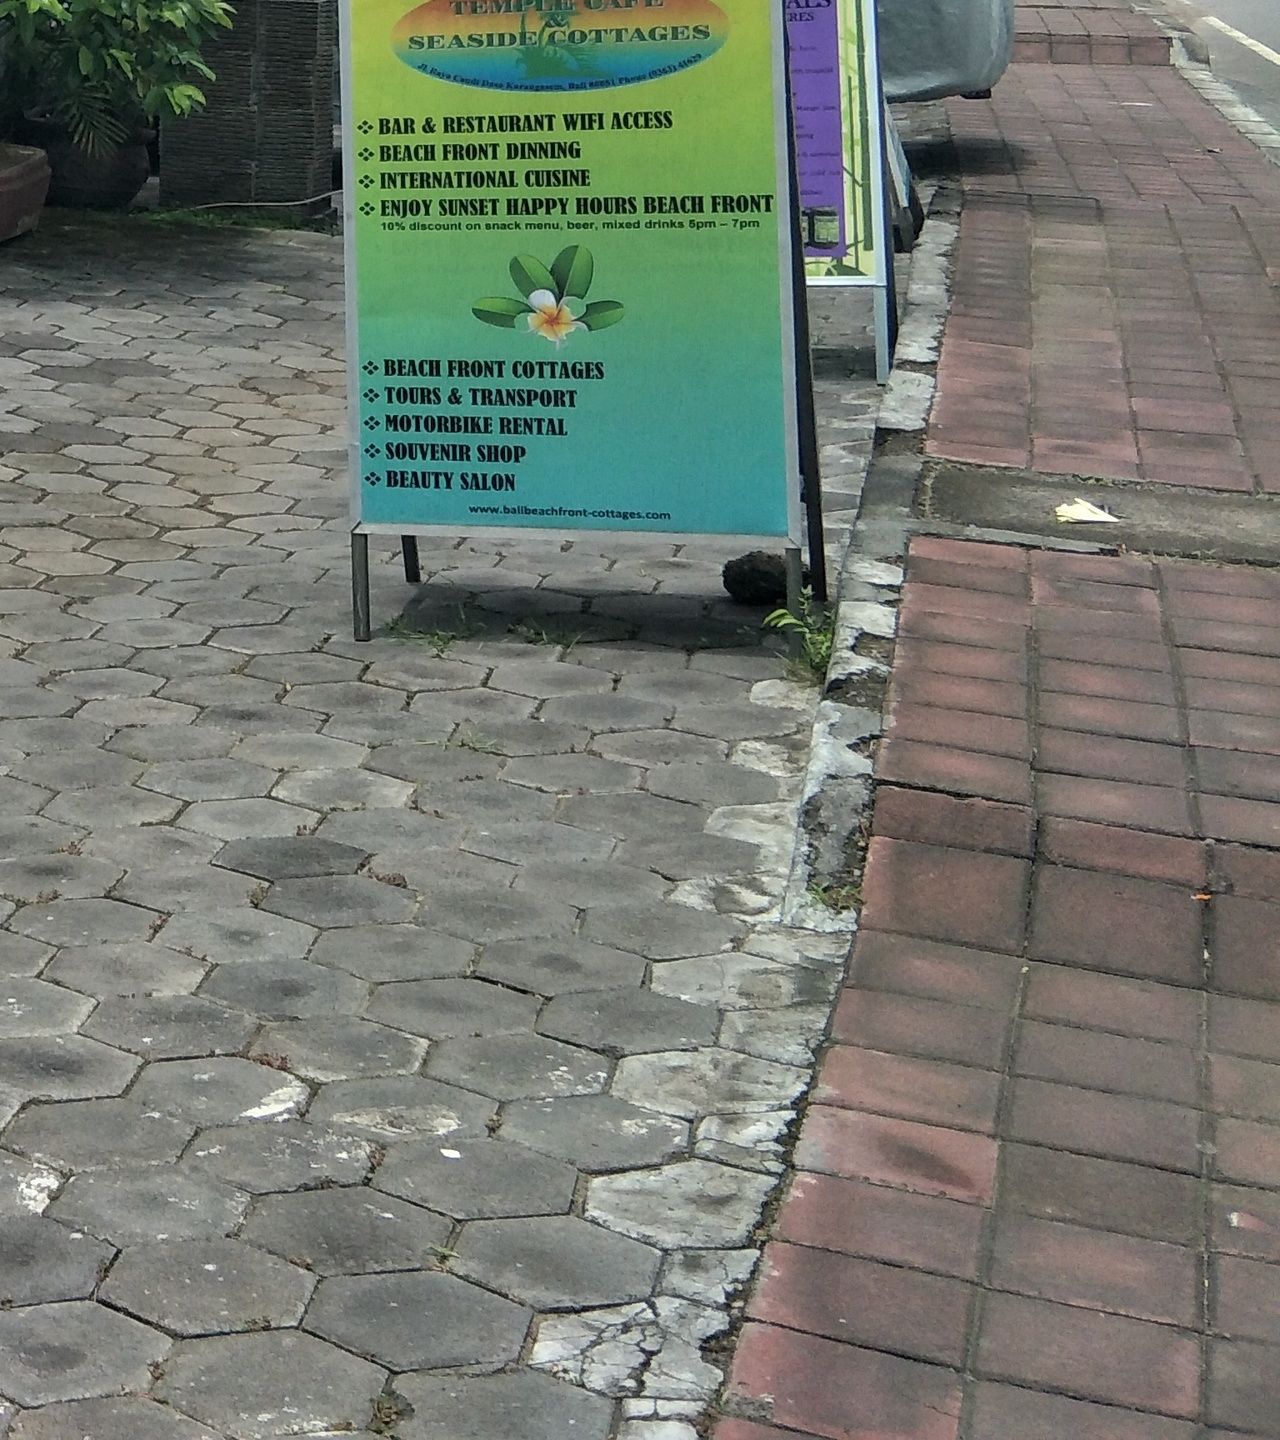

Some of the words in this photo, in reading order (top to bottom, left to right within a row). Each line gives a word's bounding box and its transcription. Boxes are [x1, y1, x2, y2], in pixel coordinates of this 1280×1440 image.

[545, 13, 569, 29] &
[408, 30, 541, 51] SEASIDE
[547, 24, 711, 45] COTTAGES
[453, 74, 480, 86] Candi
[378, 116, 417, 135] BAR
[421, 116, 436, 135] &
[443, 114, 556, 134] RESTAURANT
[562, 112, 605, 131] WIFI
[611, 110, 673, 131] ACCESS
[378, 142, 437, 162] BEACH
[442, 141, 502, 161] FRONT
[505, 140, 581, 160] DINNING
[379, 169, 519, 190] INTERNATIONAL
[523, 168, 591, 188] CUISINE
[380, 198, 433, 219] ENJOY
[438, 197, 501, 217] SUNSET
[505, 196, 571, 216] HAPPY
[575, 196, 638, 216] HOURS
[643, 195, 706, 215] BEACH
[710, 193, 774, 214] FRONT
[381, 221, 407, 231] 10%
[409, 221, 461, 231] discount
[464, 223, 481, 231] on
[484, 220, 522, 230] snack
[524, 222, 564, 232] menu,
[566, 220, 598, 231] beer,
[601, 219, 640, 230] mixed
[644, 219, 685, 230] drinks
[688, 219, 717, 232] 5pm
[732, 219, 760, 232] 7pm
[383, 359, 441, 378] BEACH
[447, 360, 506, 378] FRONT
[512, 361, 605, 380] COTTAGES
[384, 386, 441, 405] TOURS
[447, 388, 462, 405] &
[468, 388, 578, 408] TRANSPORT
[384, 415, 493, 434] MOTORBIKE
[499, 416, 568, 436] RENTAL
[385, 443, 472, 462] SOUVENIR
[477, 444, 527, 464] SHOP
[386, 470, 454, 490] BEAUTY
[460, 471, 516, 492] SALON
[468, 504, 671, 521] www.balibeachfront-cottages.com
